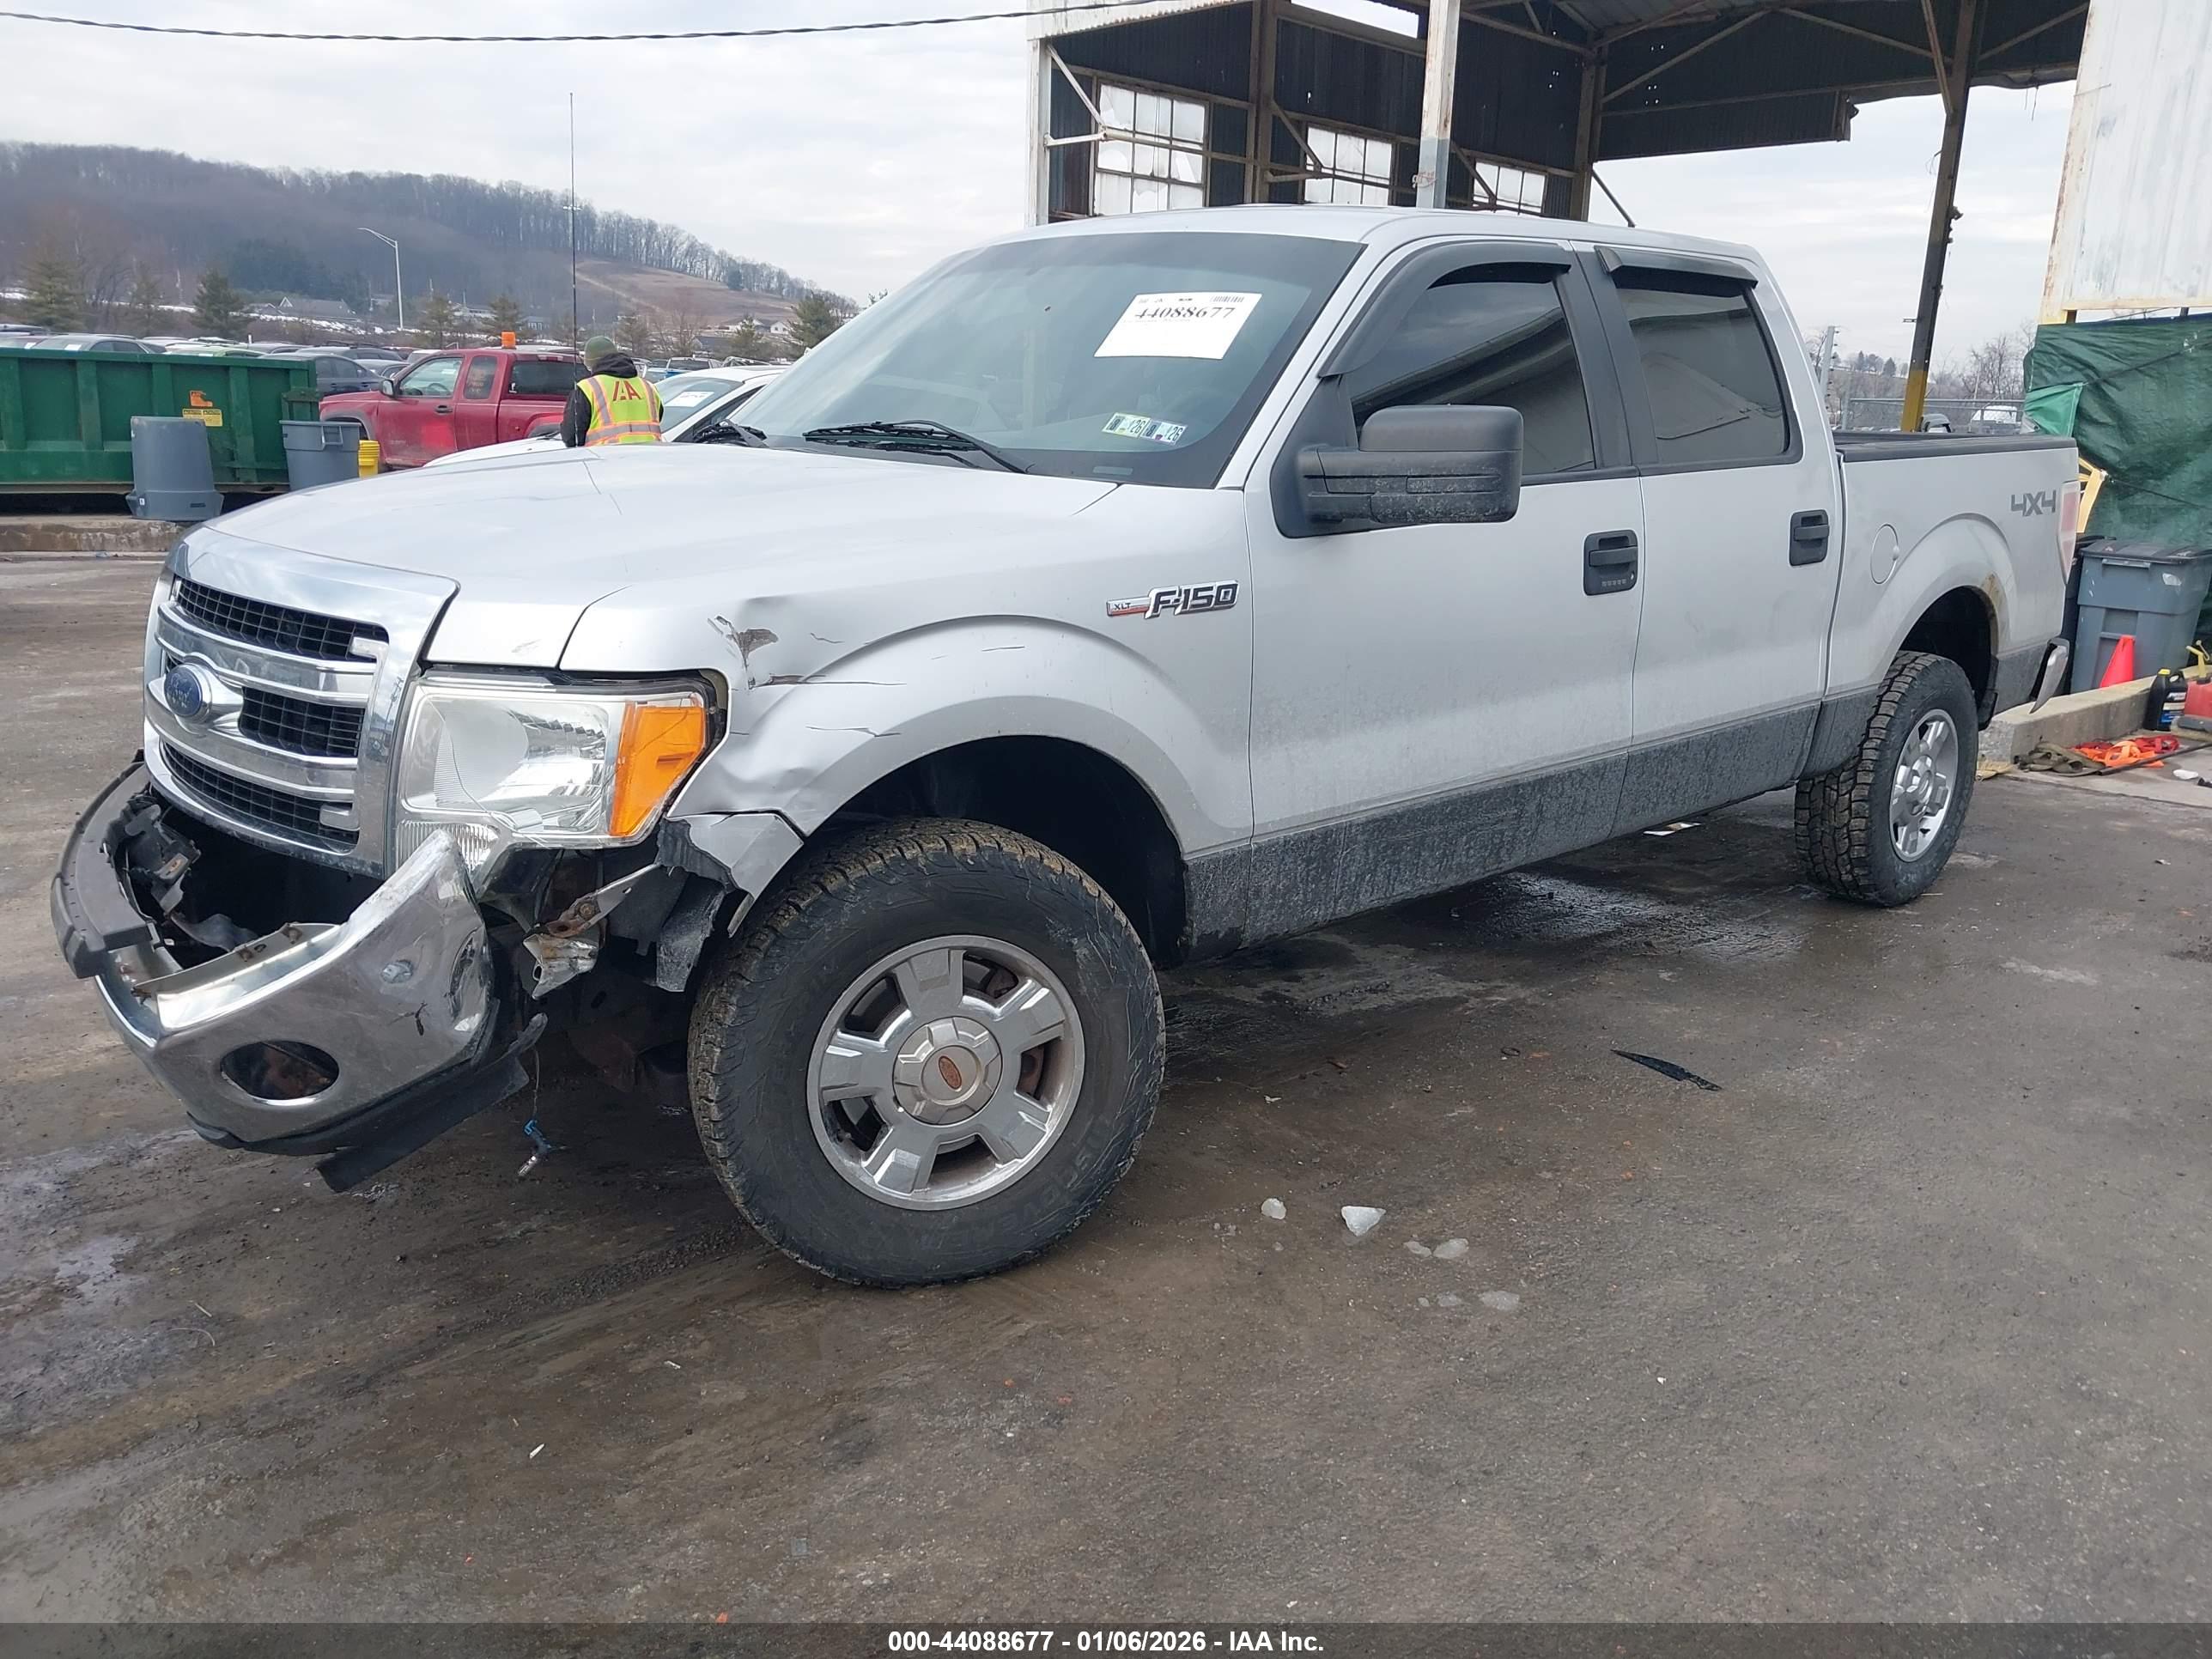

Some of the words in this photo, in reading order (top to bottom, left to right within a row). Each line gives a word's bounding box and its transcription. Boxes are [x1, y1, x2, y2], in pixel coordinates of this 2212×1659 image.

[1134, 306, 1237, 319] 44088677
[1113, 602, 1132, 611] XLT
[1146, 580, 1240, 618] F-150
